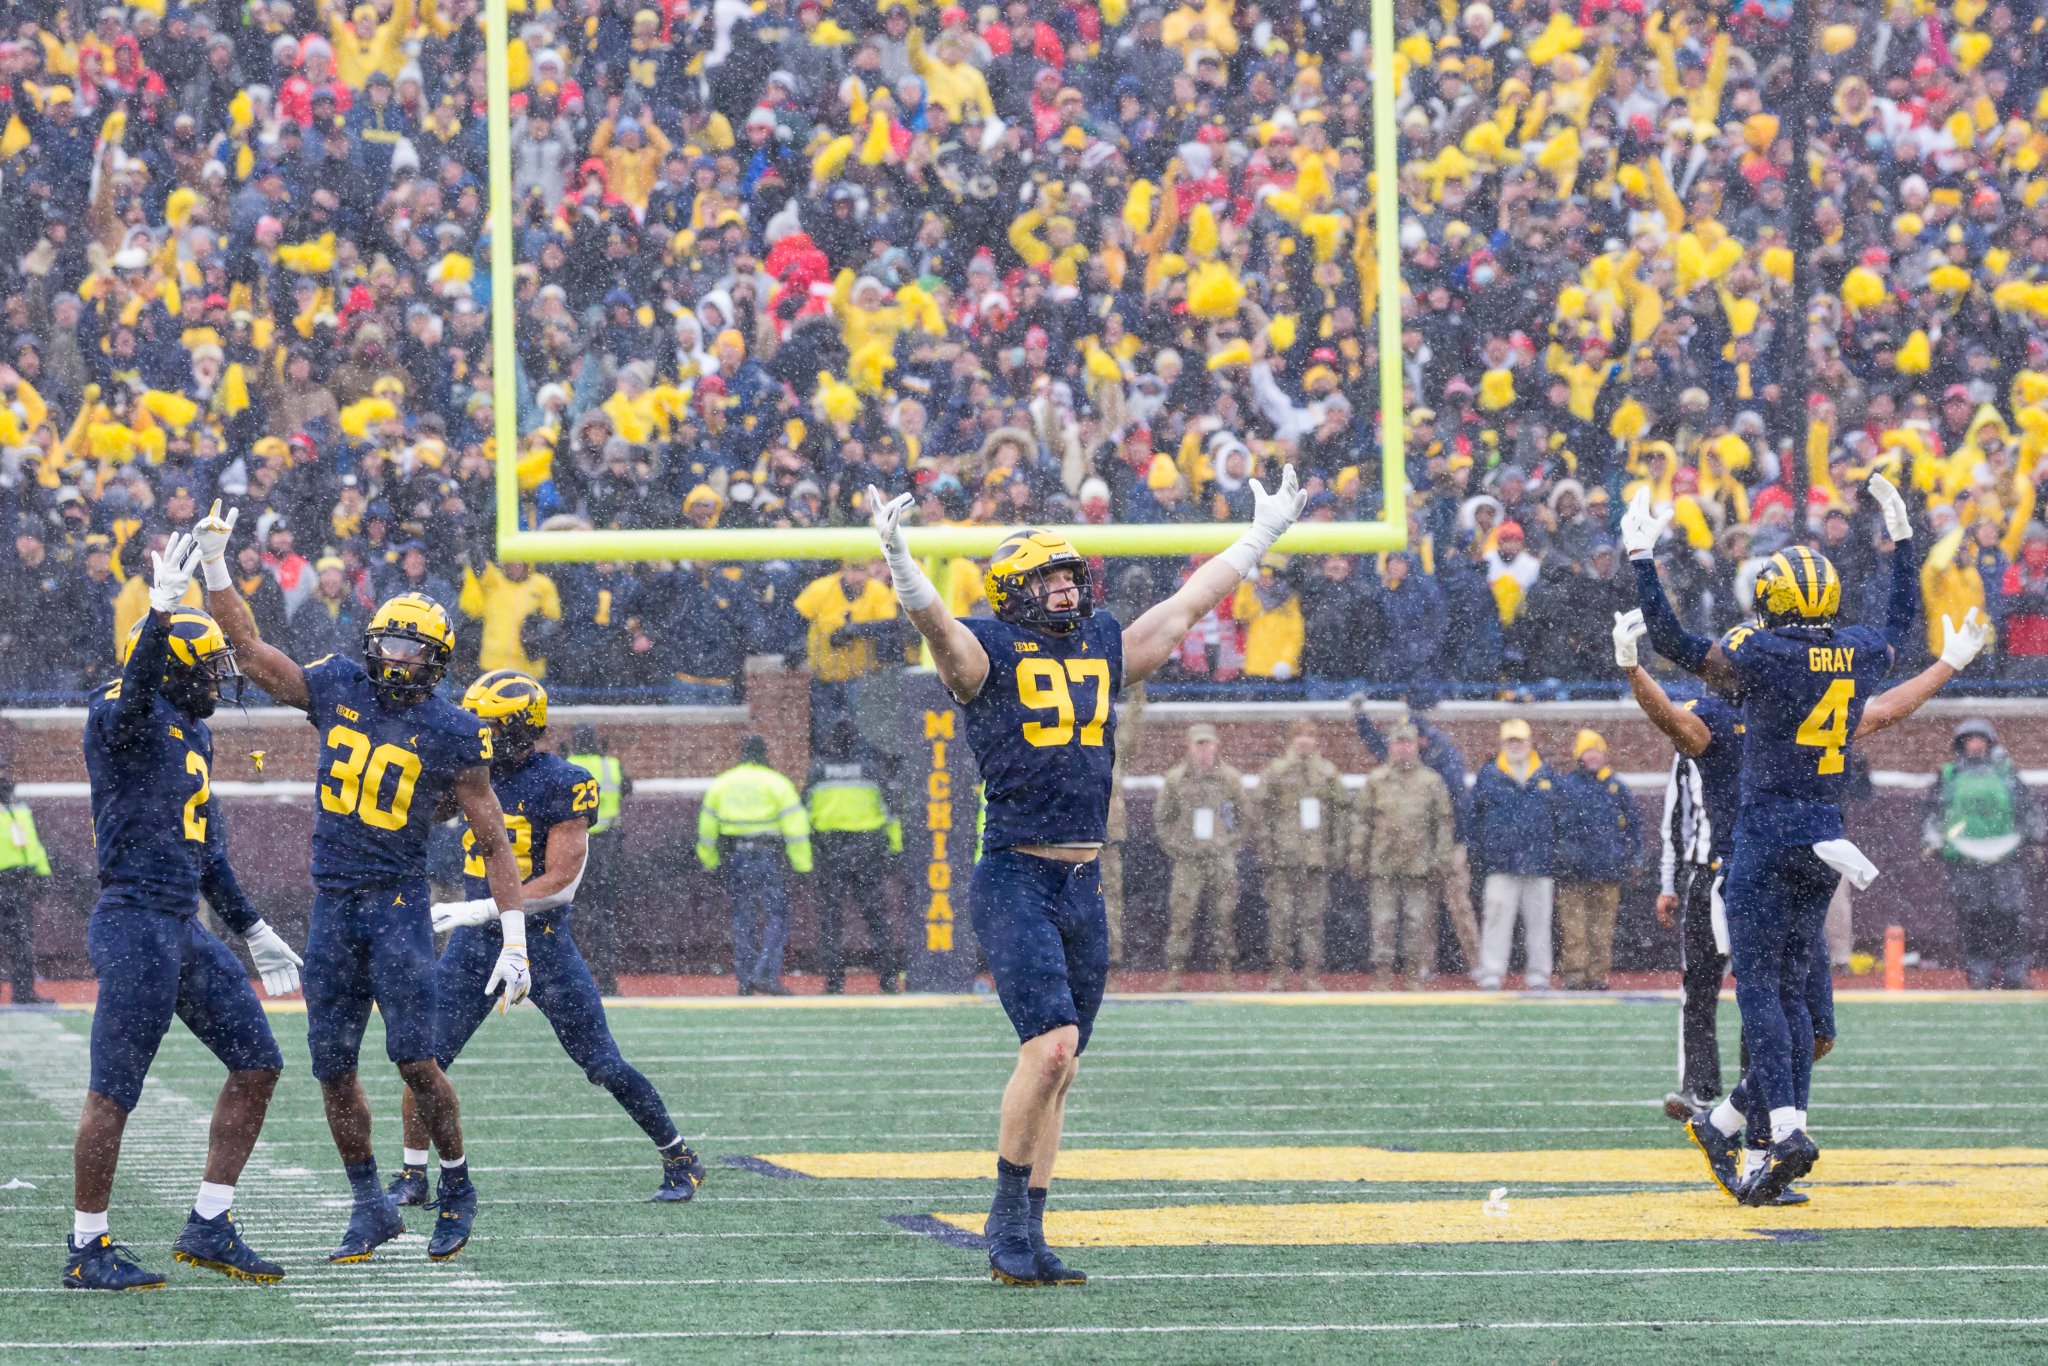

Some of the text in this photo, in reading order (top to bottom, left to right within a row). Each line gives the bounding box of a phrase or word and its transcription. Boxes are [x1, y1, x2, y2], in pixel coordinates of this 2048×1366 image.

[1016, 658, 1111, 748] 97
[1808, 647, 1854, 672] GRAY
[1795, 679, 1855, 775] 4
[184, 750, 210, 843] 2
[321, 724, 422, 832] 30
[572, 780, 600, 812] 23
[924, 709, 955, 952] MICHIGAN
